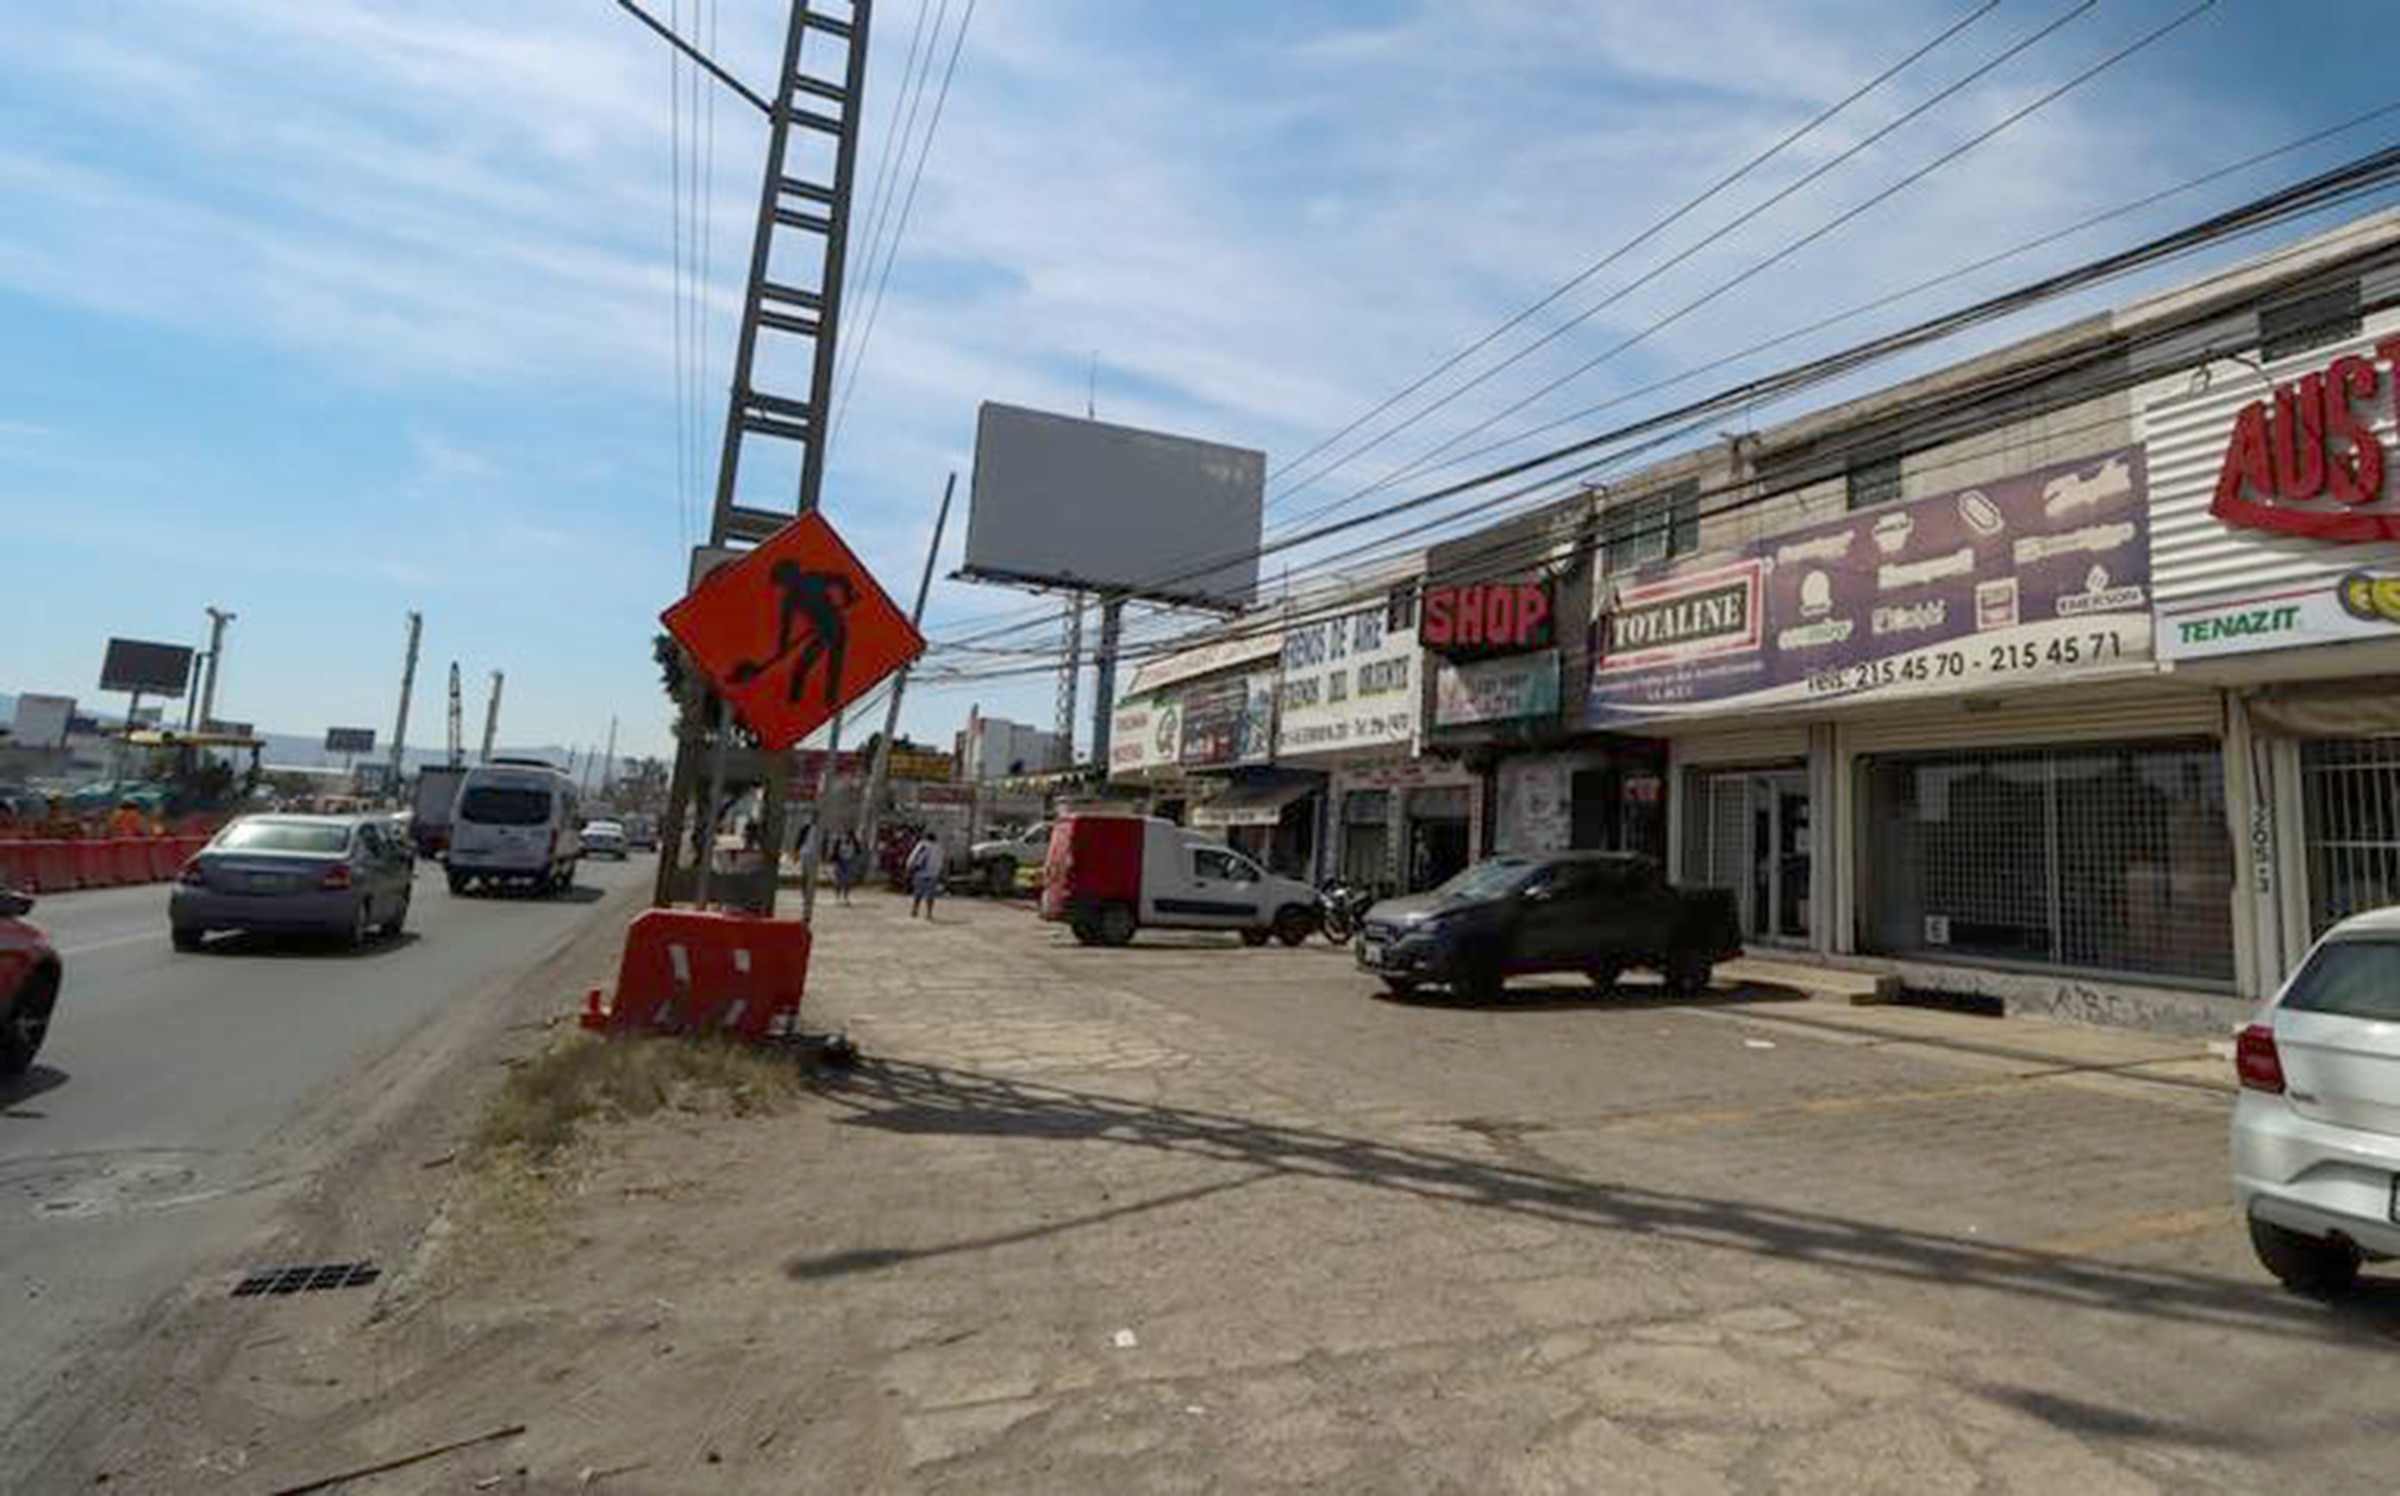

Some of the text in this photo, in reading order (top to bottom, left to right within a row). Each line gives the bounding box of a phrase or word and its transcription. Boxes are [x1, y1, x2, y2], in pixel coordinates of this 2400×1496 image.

[1425, 583, 1548, 645] SHOP
[1612, 592, 1742, 647] TOTALINE
[2178, 607, 2300, 644] TENAZIT
[1855, 660, 1895, 688] 215
[1901, 656, 1929, 681] 45
[1937, 651, 1965, 677] 70
[1990, 642, 2037, 671] 215
[2046, 636, 2079, 664] 45
[2089, 631, 2121, 658] 71
